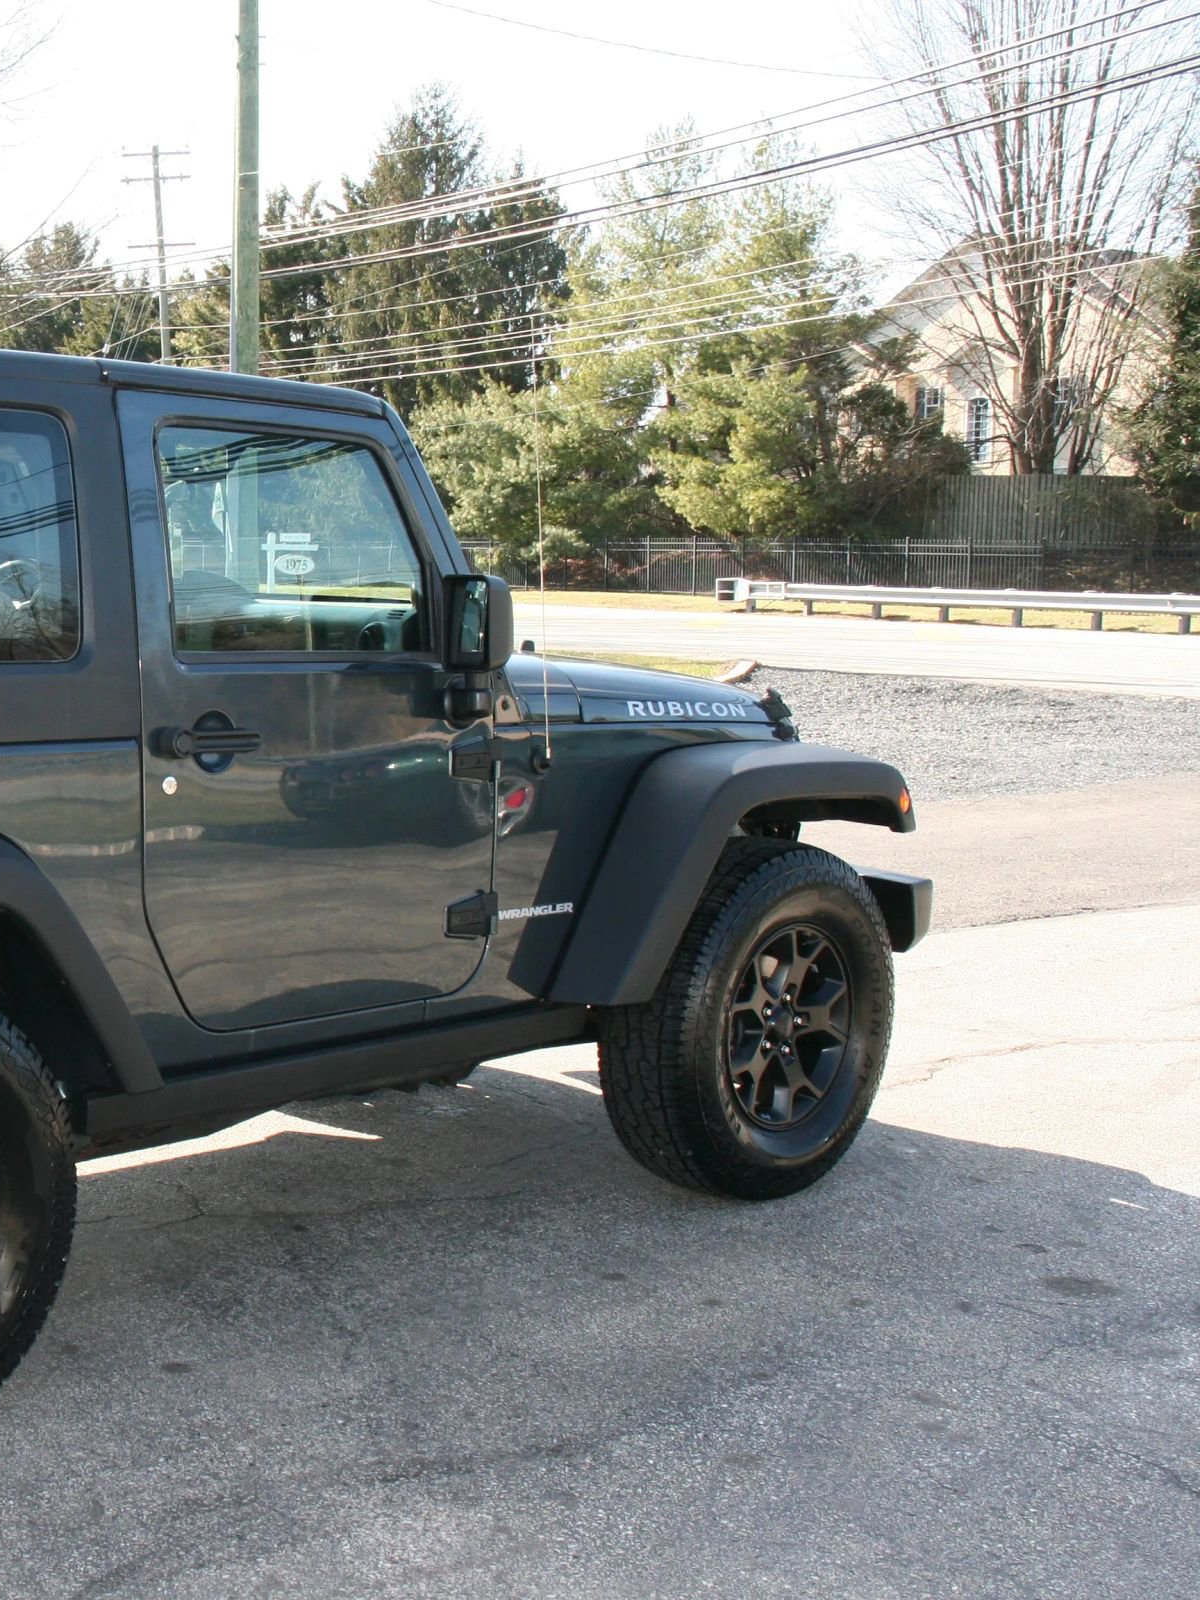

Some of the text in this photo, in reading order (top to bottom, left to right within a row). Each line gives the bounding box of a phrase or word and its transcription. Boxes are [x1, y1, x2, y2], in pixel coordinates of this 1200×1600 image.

[286, 559, 308, 571] 1975
[627, 700, 747, 717] RUBICON
[498, 902, 574, 920] WRANGLER
